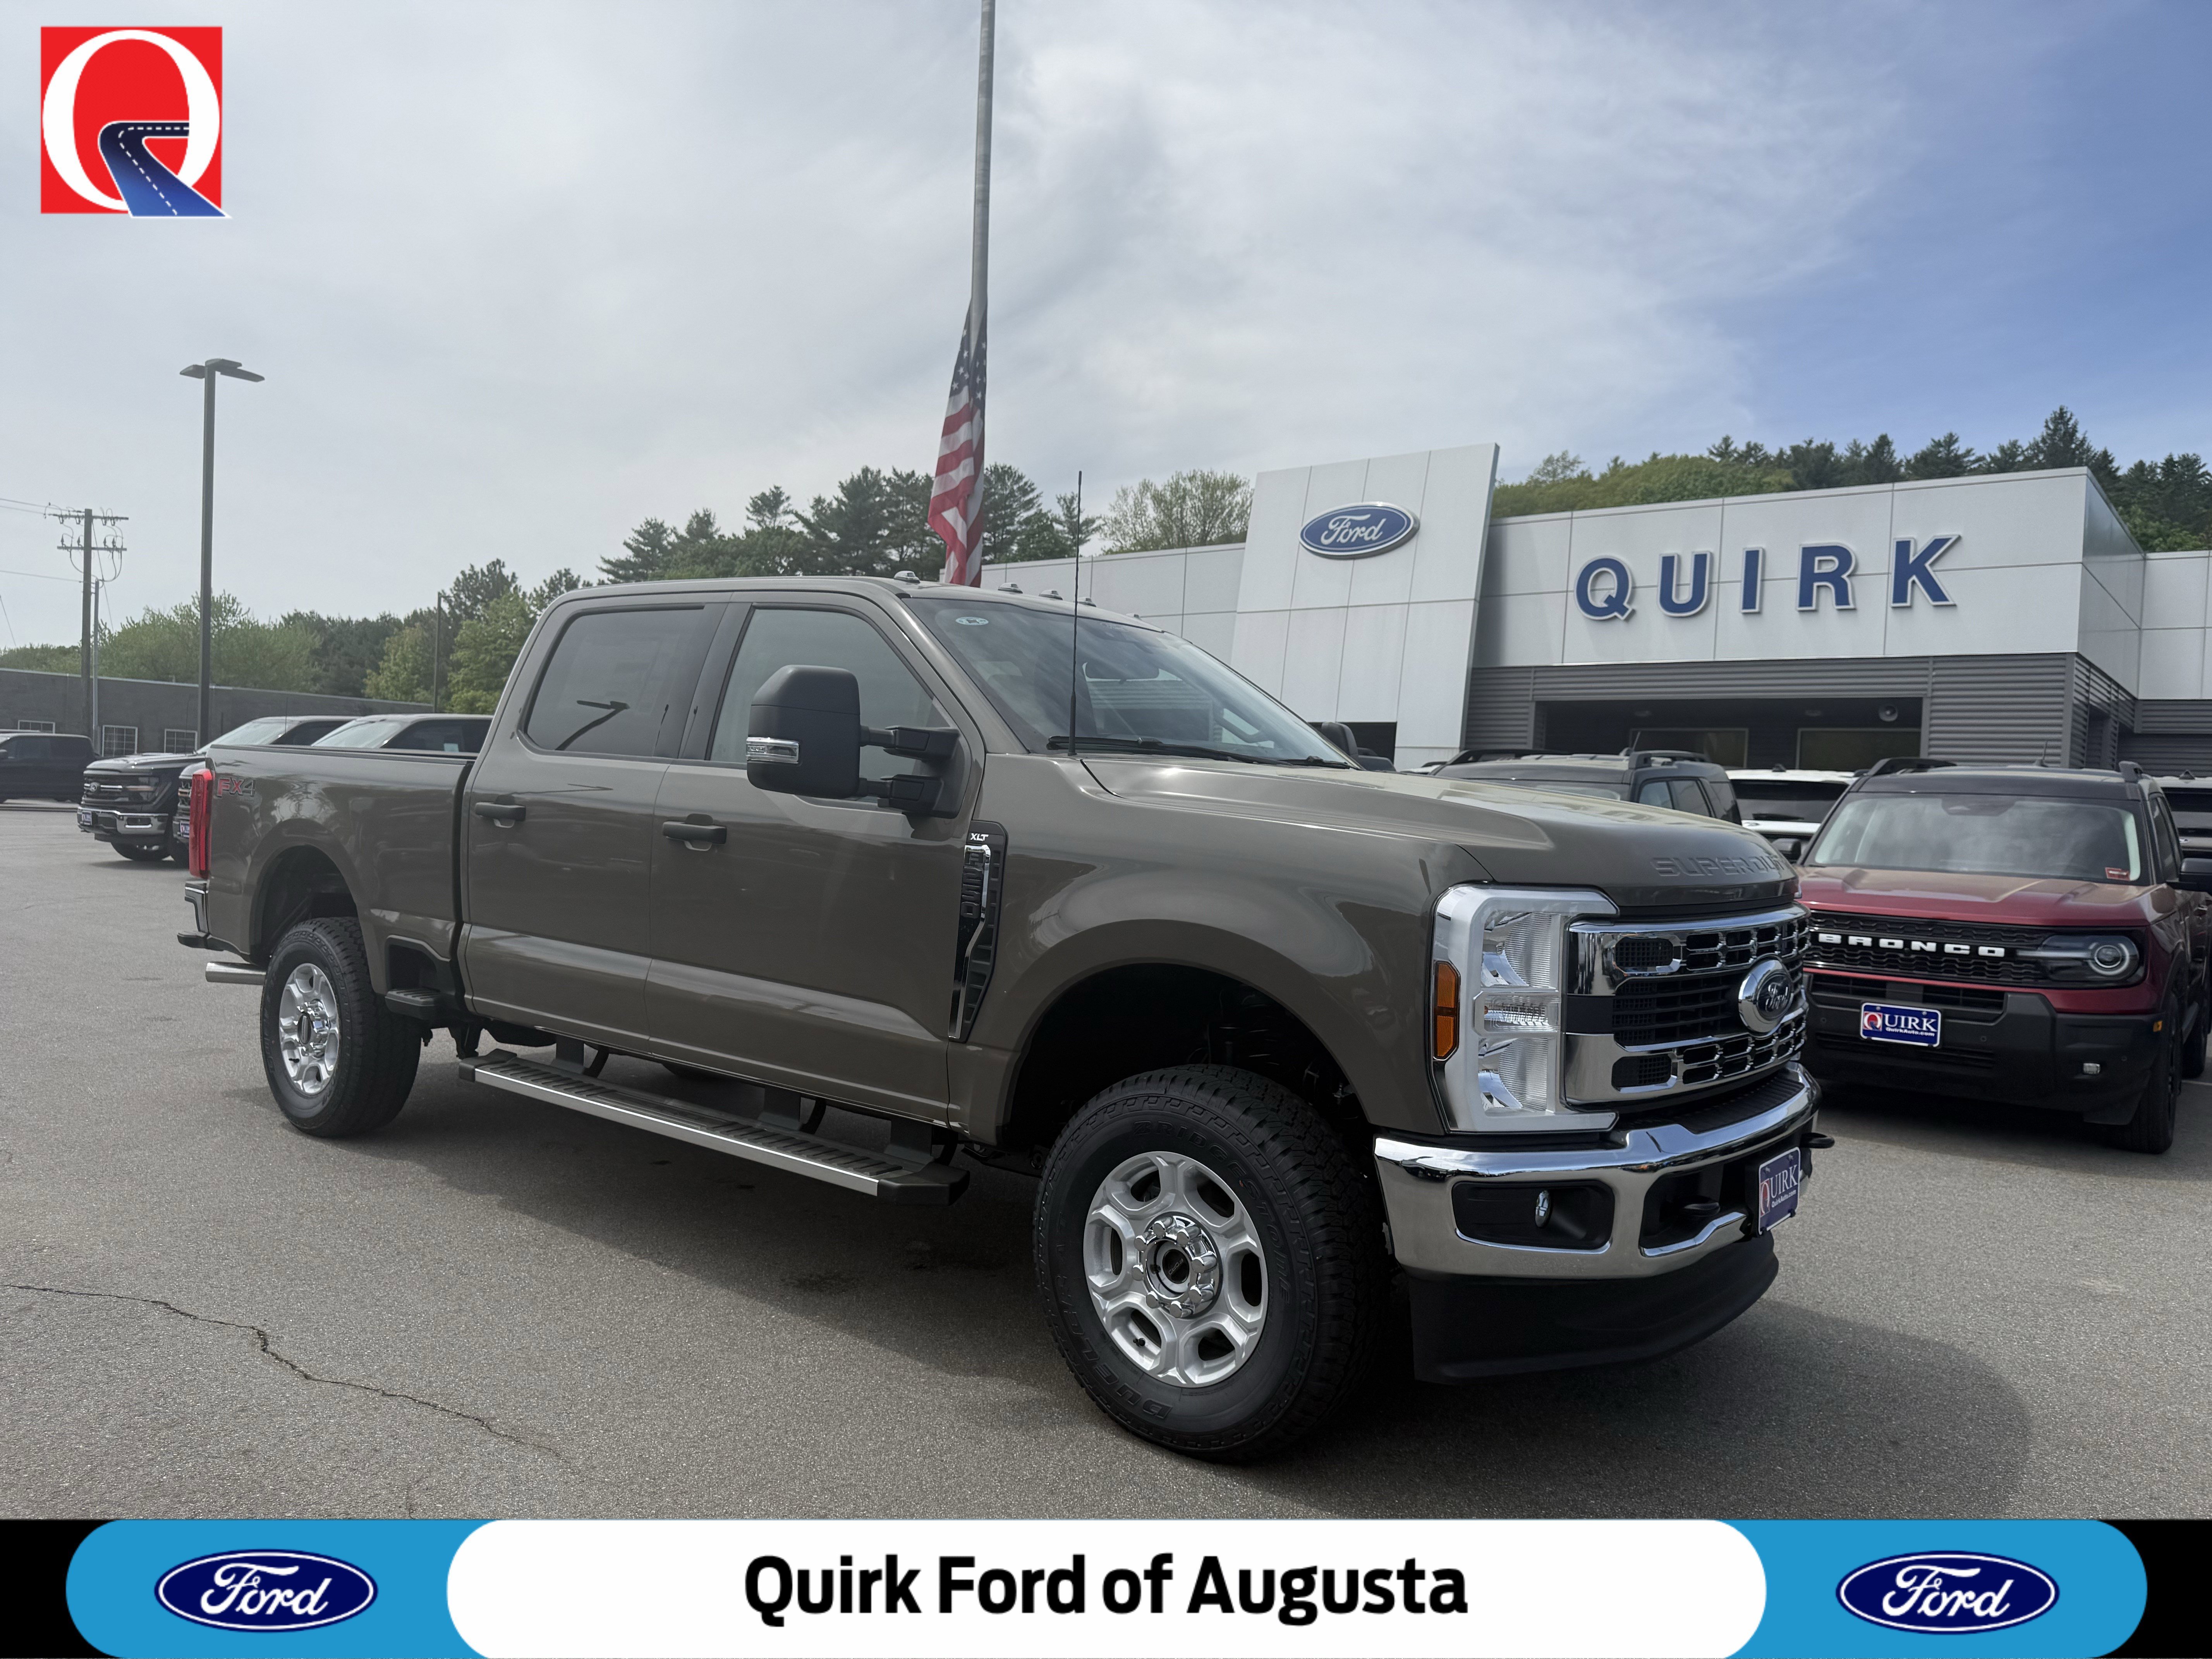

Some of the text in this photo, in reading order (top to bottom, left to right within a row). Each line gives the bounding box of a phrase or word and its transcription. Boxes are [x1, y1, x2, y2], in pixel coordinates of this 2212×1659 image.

[1321, 514, 1387, 545] Ford
[1575, 534, 1960, 621] QUIRK
[216, 777, 256, 797] FX4
[970, 833, 989, 841] XLT
[1819, 933, 2005, 957] BRONCO
[1864, 1012, 1938, 1032] QUIRK
[1761, 1164, 1798, 1214] QUIRK
